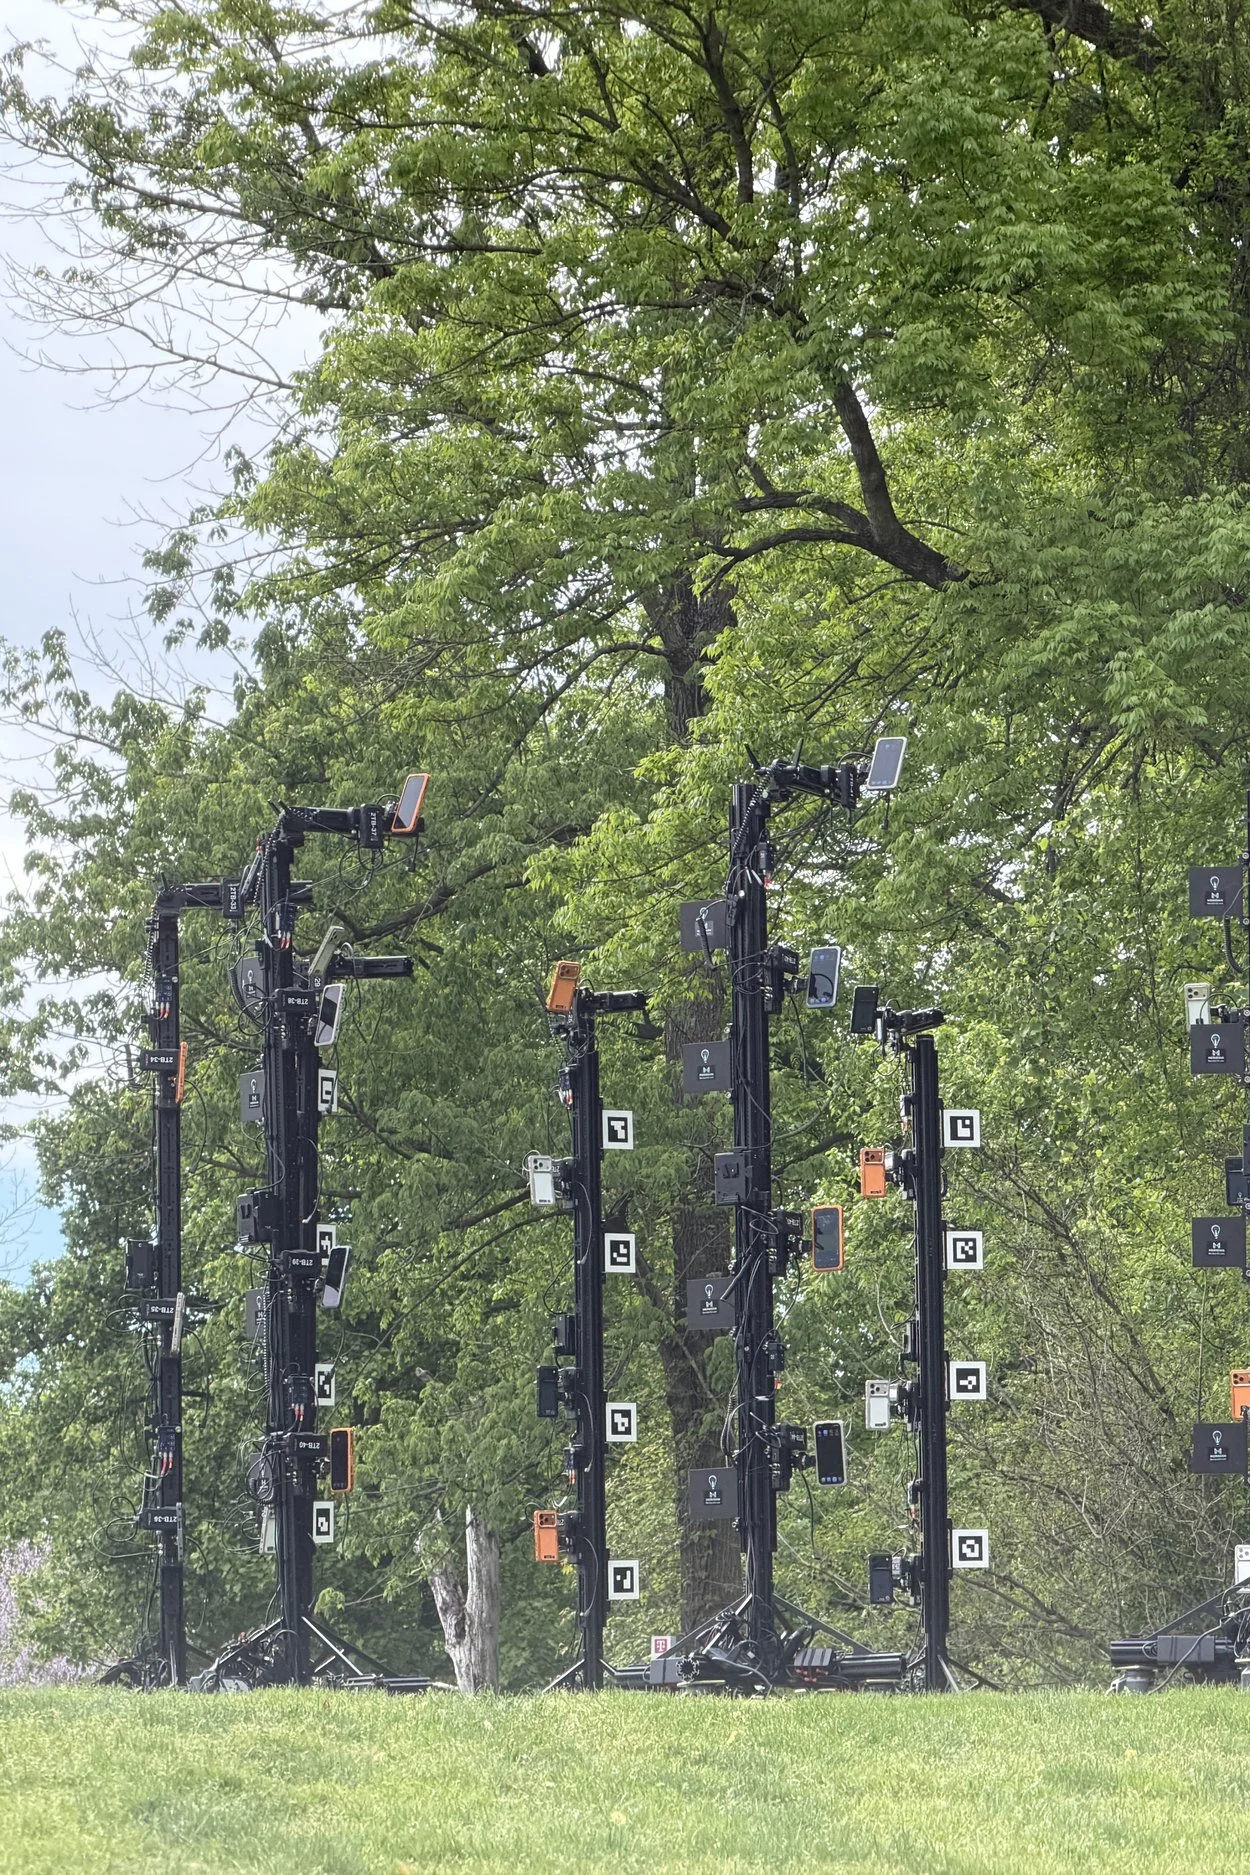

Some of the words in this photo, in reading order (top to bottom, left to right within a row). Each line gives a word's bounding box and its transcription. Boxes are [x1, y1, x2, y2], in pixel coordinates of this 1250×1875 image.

[370, 812, 378, 837] 2TB-37
[229, 886, 238, 910] 2TB-33
[150, 1056, 174, 1064] 2TB-34
[150, 1305, 174, 1314] 2TB-35
[298, 1441, 321, 1450] 2TB-40
